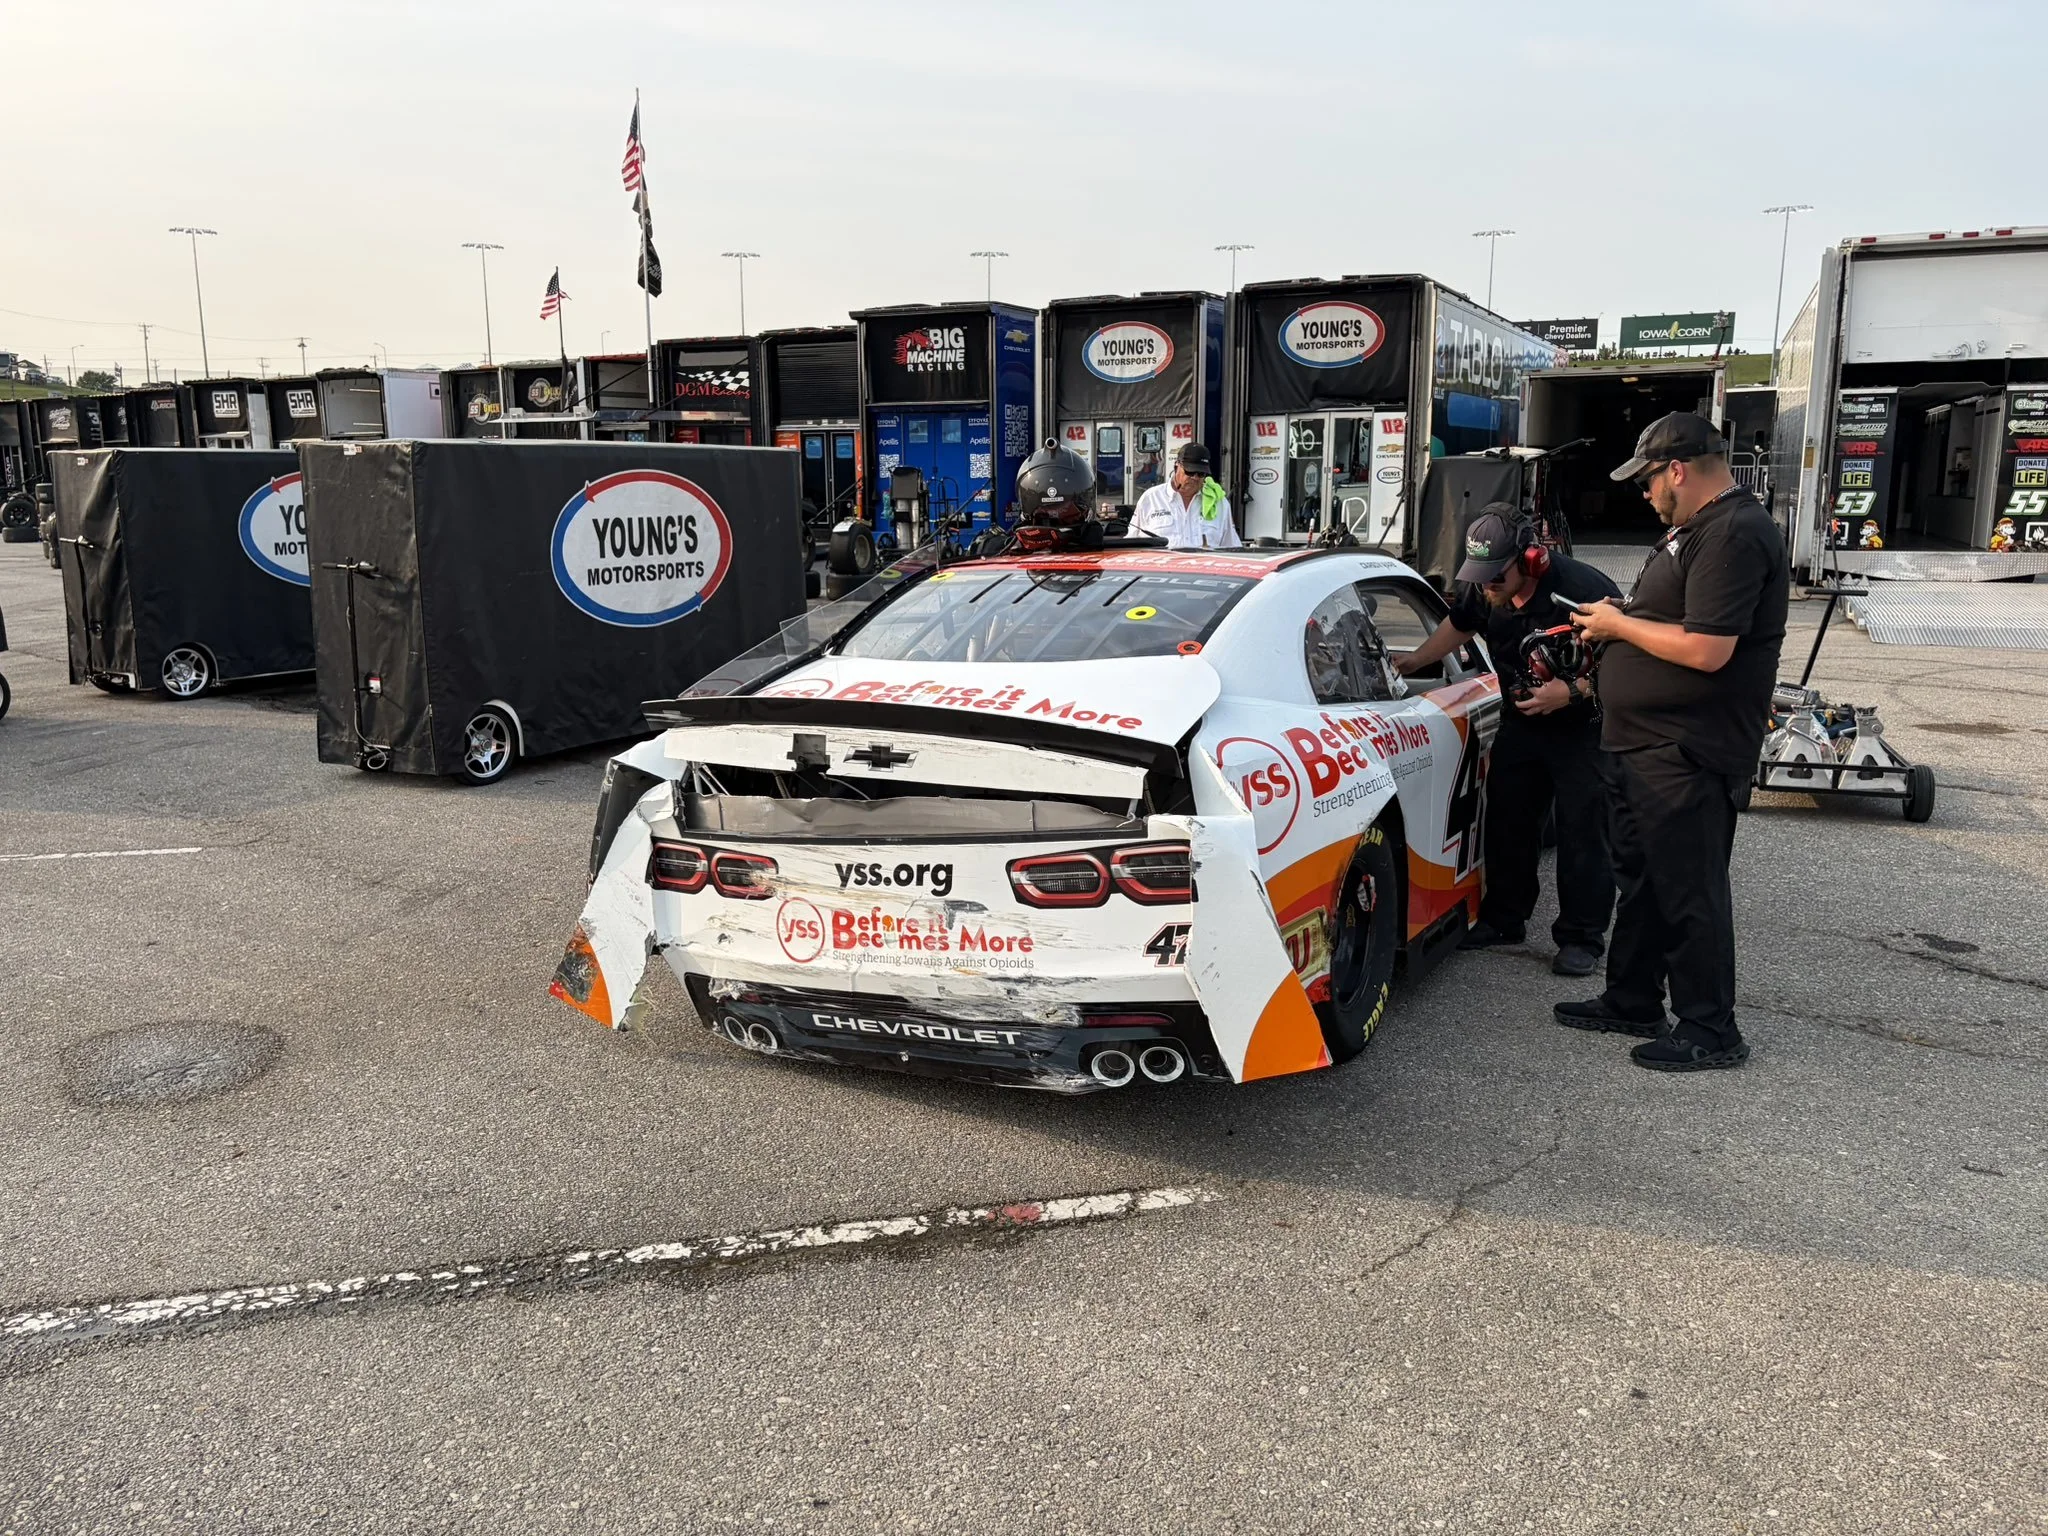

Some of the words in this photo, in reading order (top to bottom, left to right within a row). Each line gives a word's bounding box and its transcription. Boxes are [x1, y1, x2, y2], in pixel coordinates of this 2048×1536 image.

[1301, 320, 1362, 338] YOUNG'S
[1545, 333, 1565, 341] Chevy
[1566, 332, 1592, 340] Dealers
[1550, 325, 1588, 333] Premier
[1639, 329, 1669, 339] IOWA
[1677, 328, 1711, 338] CORN
[929, 327, 965, 348] BIG
[1296, 340, 1365, 350] MOTORSPORTS
[1102, 338, 1154, 356] YOUNG'S
[907, 350, 965, 364] MACHINE
[1097, 357, 1157, 367] MOTORSPORTS
[907, 363, 965, 372] RACING
[675, 382, 711, 397] DGM
[214, 394, 237, 409] SHR
[289, 392, 314, 408] SHR
[1067, 426, 1086, 441] 42
[1172, 423, 1193, 438] 42
[1844, 461, 1871, 469] DONATE
[2018, 459, 2046, 467] DONATE
[1843, 473, 1869, 485] LIFE
[2017, 472, 2044, 484] LIFE
[1834, 491, 1877, 516] 53
[592, 514, 699, 559] YOUNG'S
[587, 560, 705, 587] MOTORSPORTS
[1024, 697, 1143, 729] More
[1313, 772, 1394, 818] Strengthening
[835, 863, 954, 897] yss.org
[782, 917, 821, 943] yss
[959, 924, 1035, 953] More
[833, 950, 902, 966] Strengthening
[903, 954, 943, 967] Iowans
[944, 956, 987, 970] Against
[989, 957, 1035, 969] Opioids
[812, 1014, 1021, 1045] CHEVROLET
